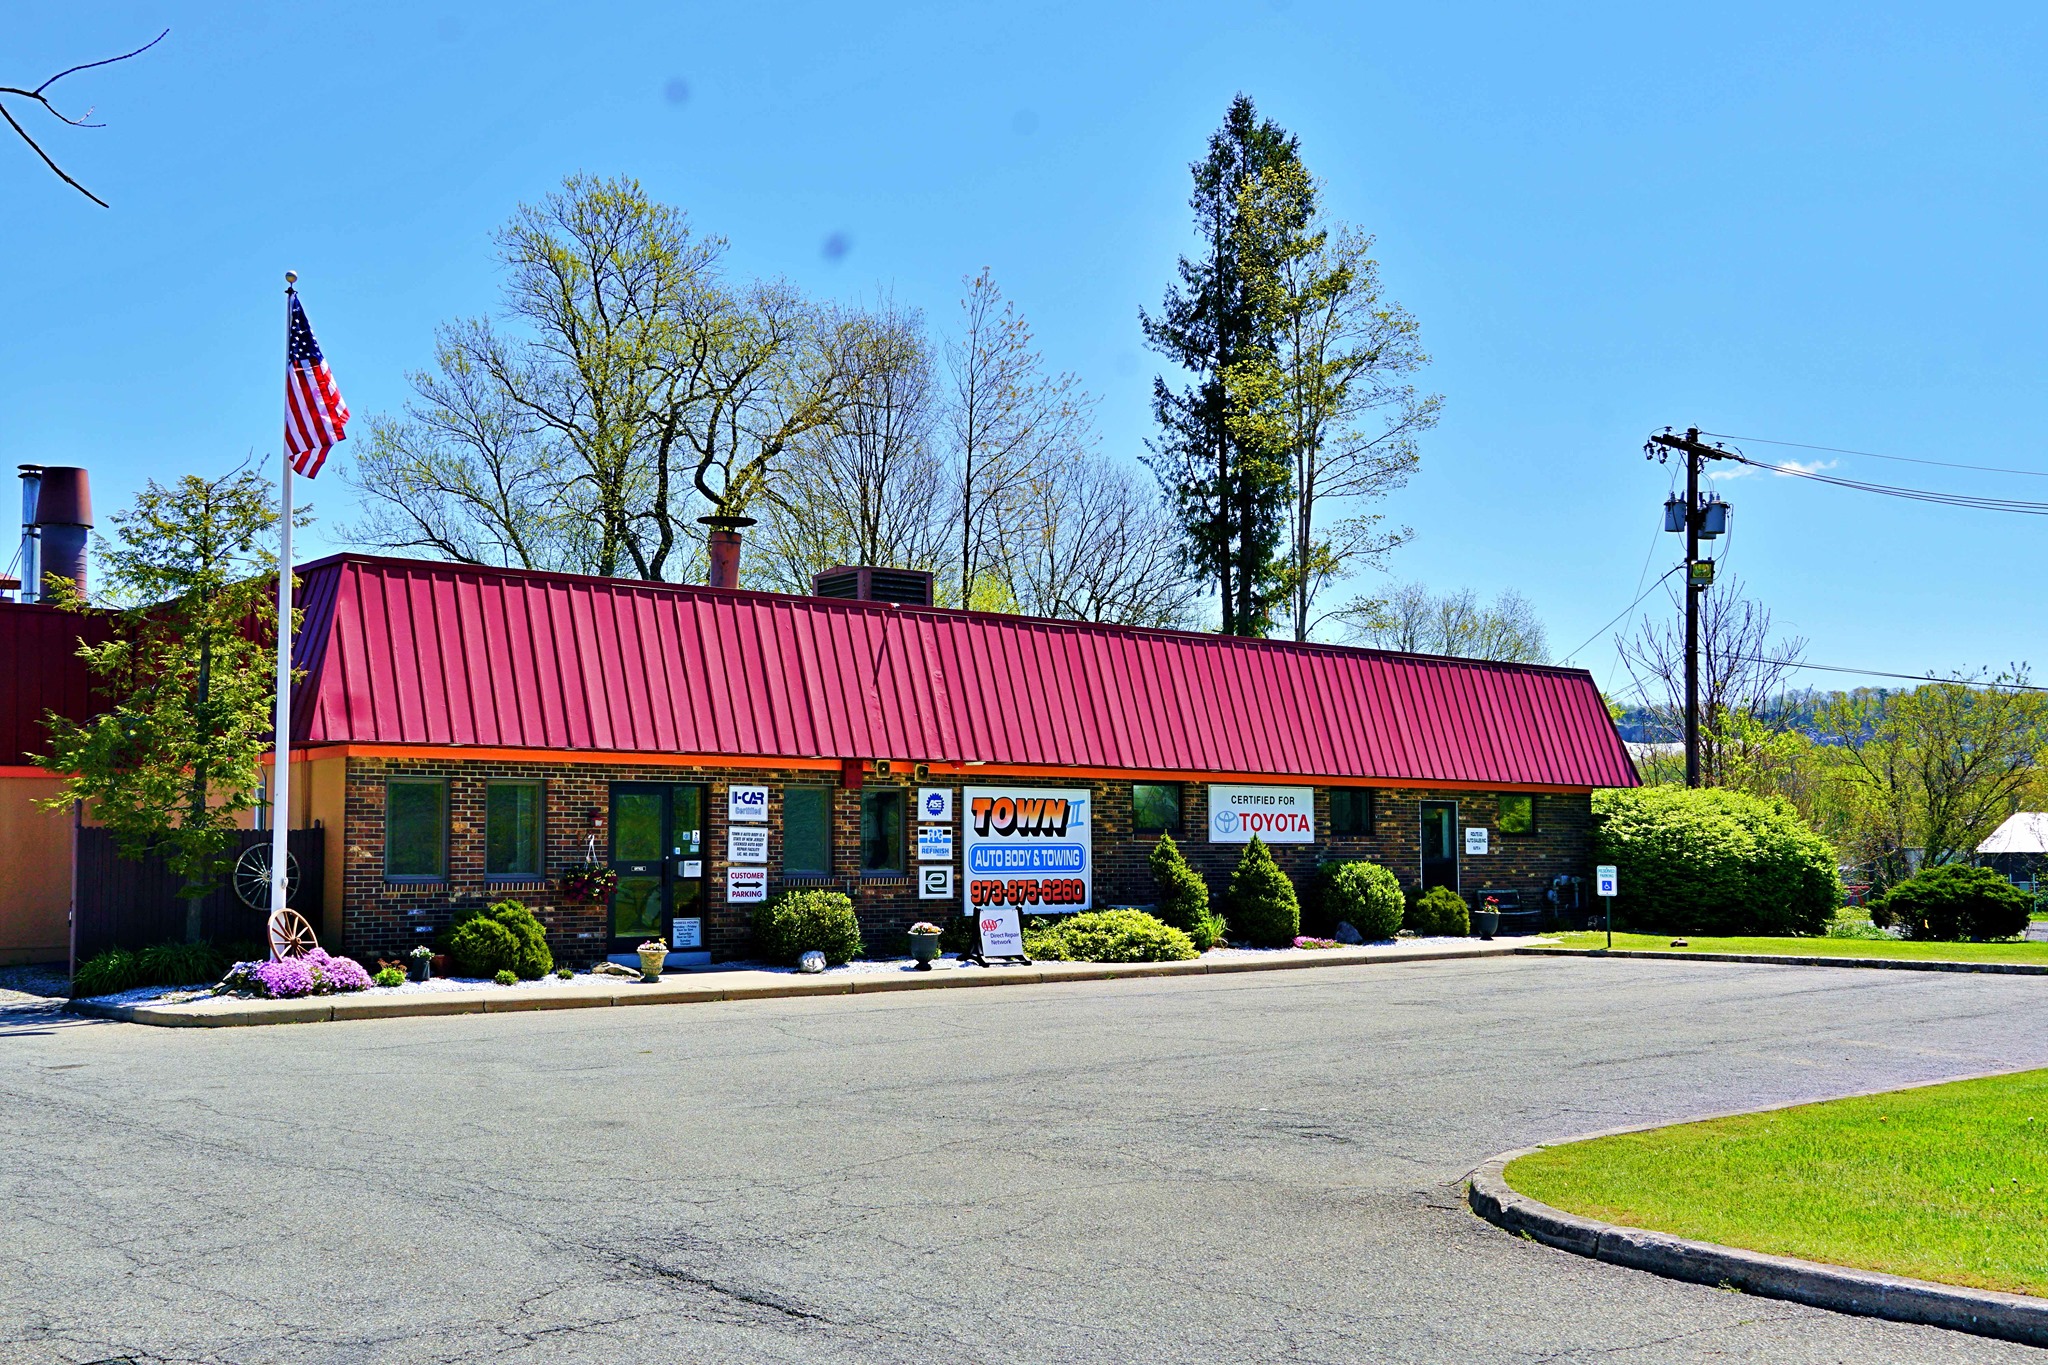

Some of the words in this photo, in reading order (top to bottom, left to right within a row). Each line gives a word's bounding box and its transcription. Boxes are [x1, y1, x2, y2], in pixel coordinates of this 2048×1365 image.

[732, 791, 765, 805] I-CAR
[928, 799, 943, 808] ASE
[1230, 795, 1276, 805] CERTIFIED
[1278, 796, 1295, 805] FOR
[735, 806, 762, 815] Certified
[971, 797, 1069, 837] TOWN
[1066, 800, 1085, 828] II
[1238, 812, 1311, 833] TOYOTA
[928, 829, 943, 843] PPG
[975, 849, 1003, 867] AUTO
[1004, 849, 1032, 867] BODY
[1033, 849, 1041, 867] &
[1041, 849, 1080, 867] TOWING
[970, 879, 1085, 906] 973-875-6260
